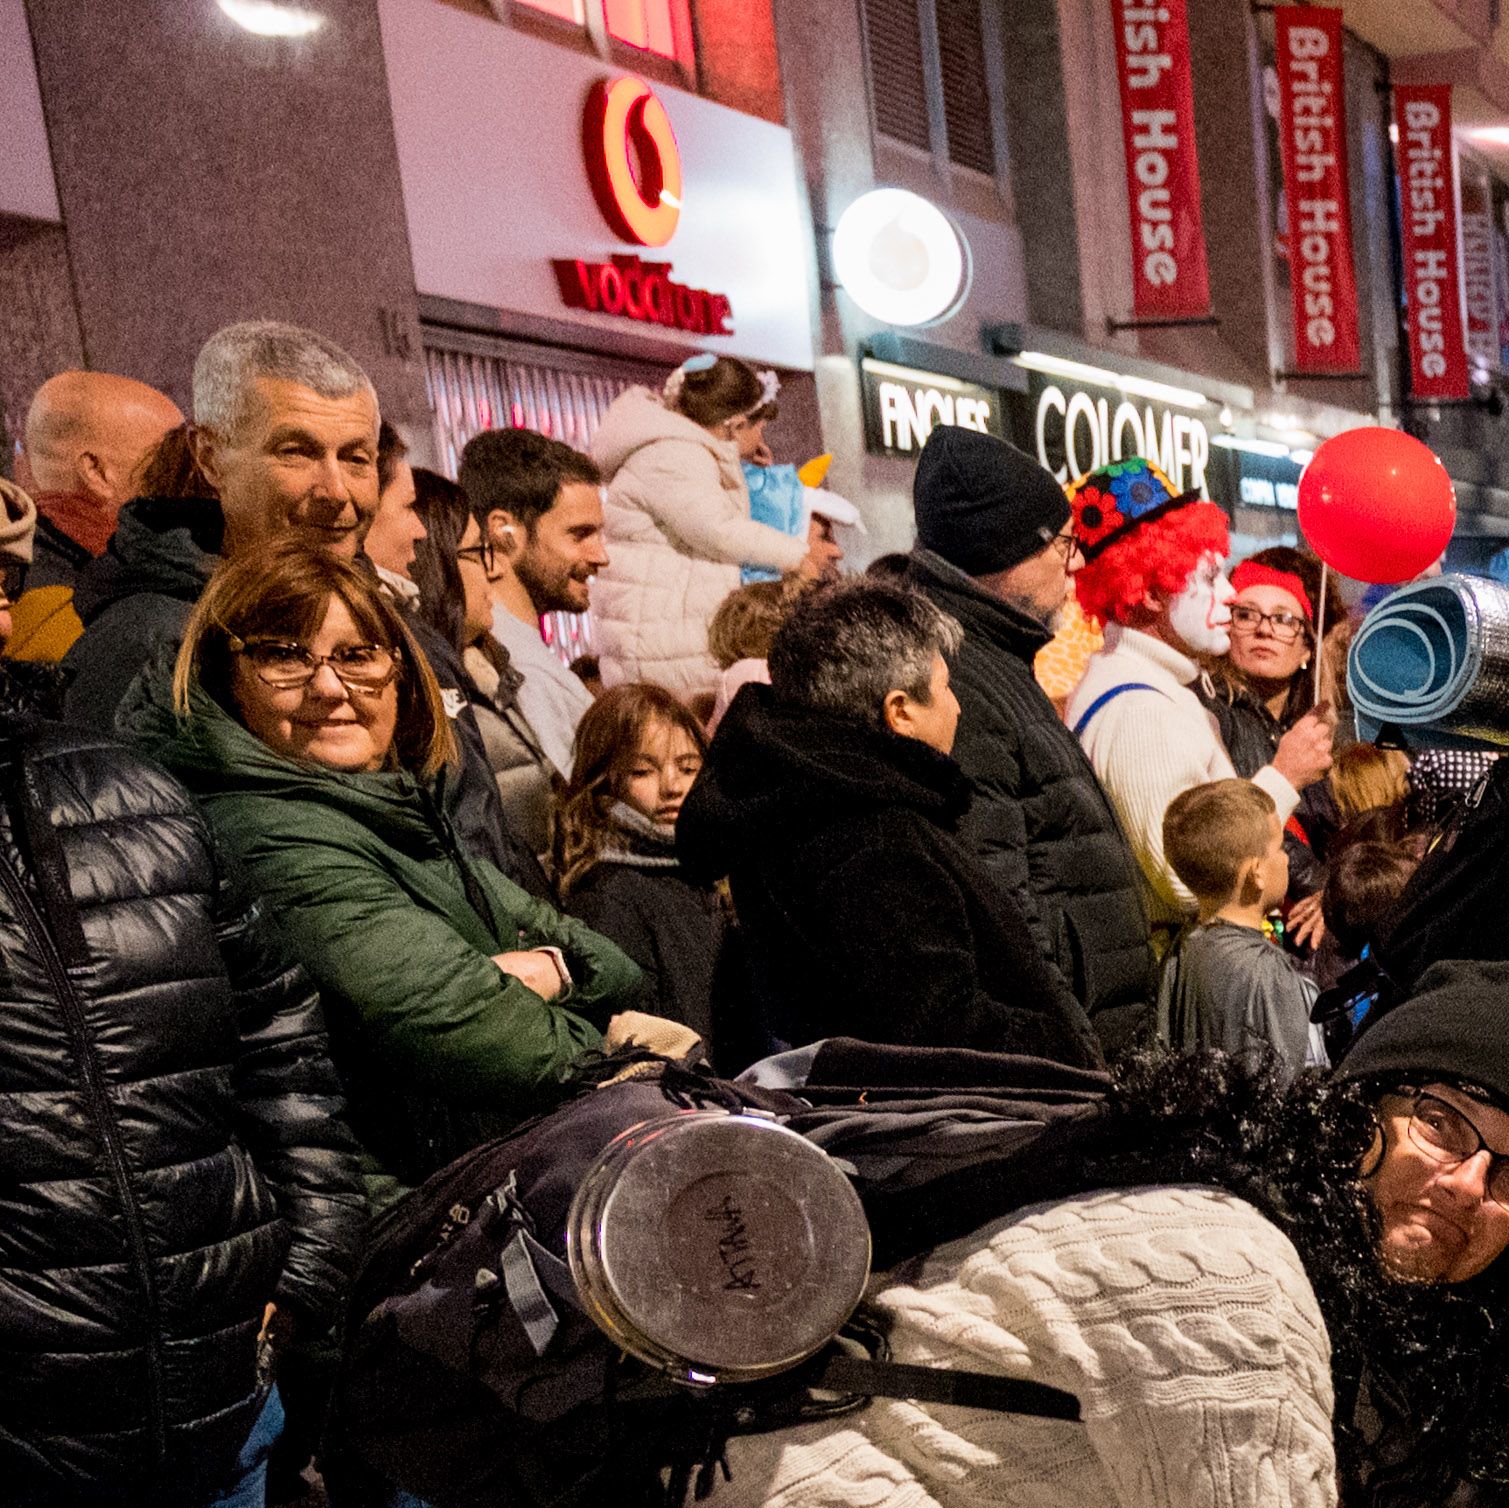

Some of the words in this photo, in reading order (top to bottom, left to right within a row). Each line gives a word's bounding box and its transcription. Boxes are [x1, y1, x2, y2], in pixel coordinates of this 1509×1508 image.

[1288, 26, 1337, 183] British
[1404, 101, 1445, 236] British
[1132, 109, 1179, 288] House
[1300, 199, 1340, 348] House
[1414, 250, 1449, 380] House
